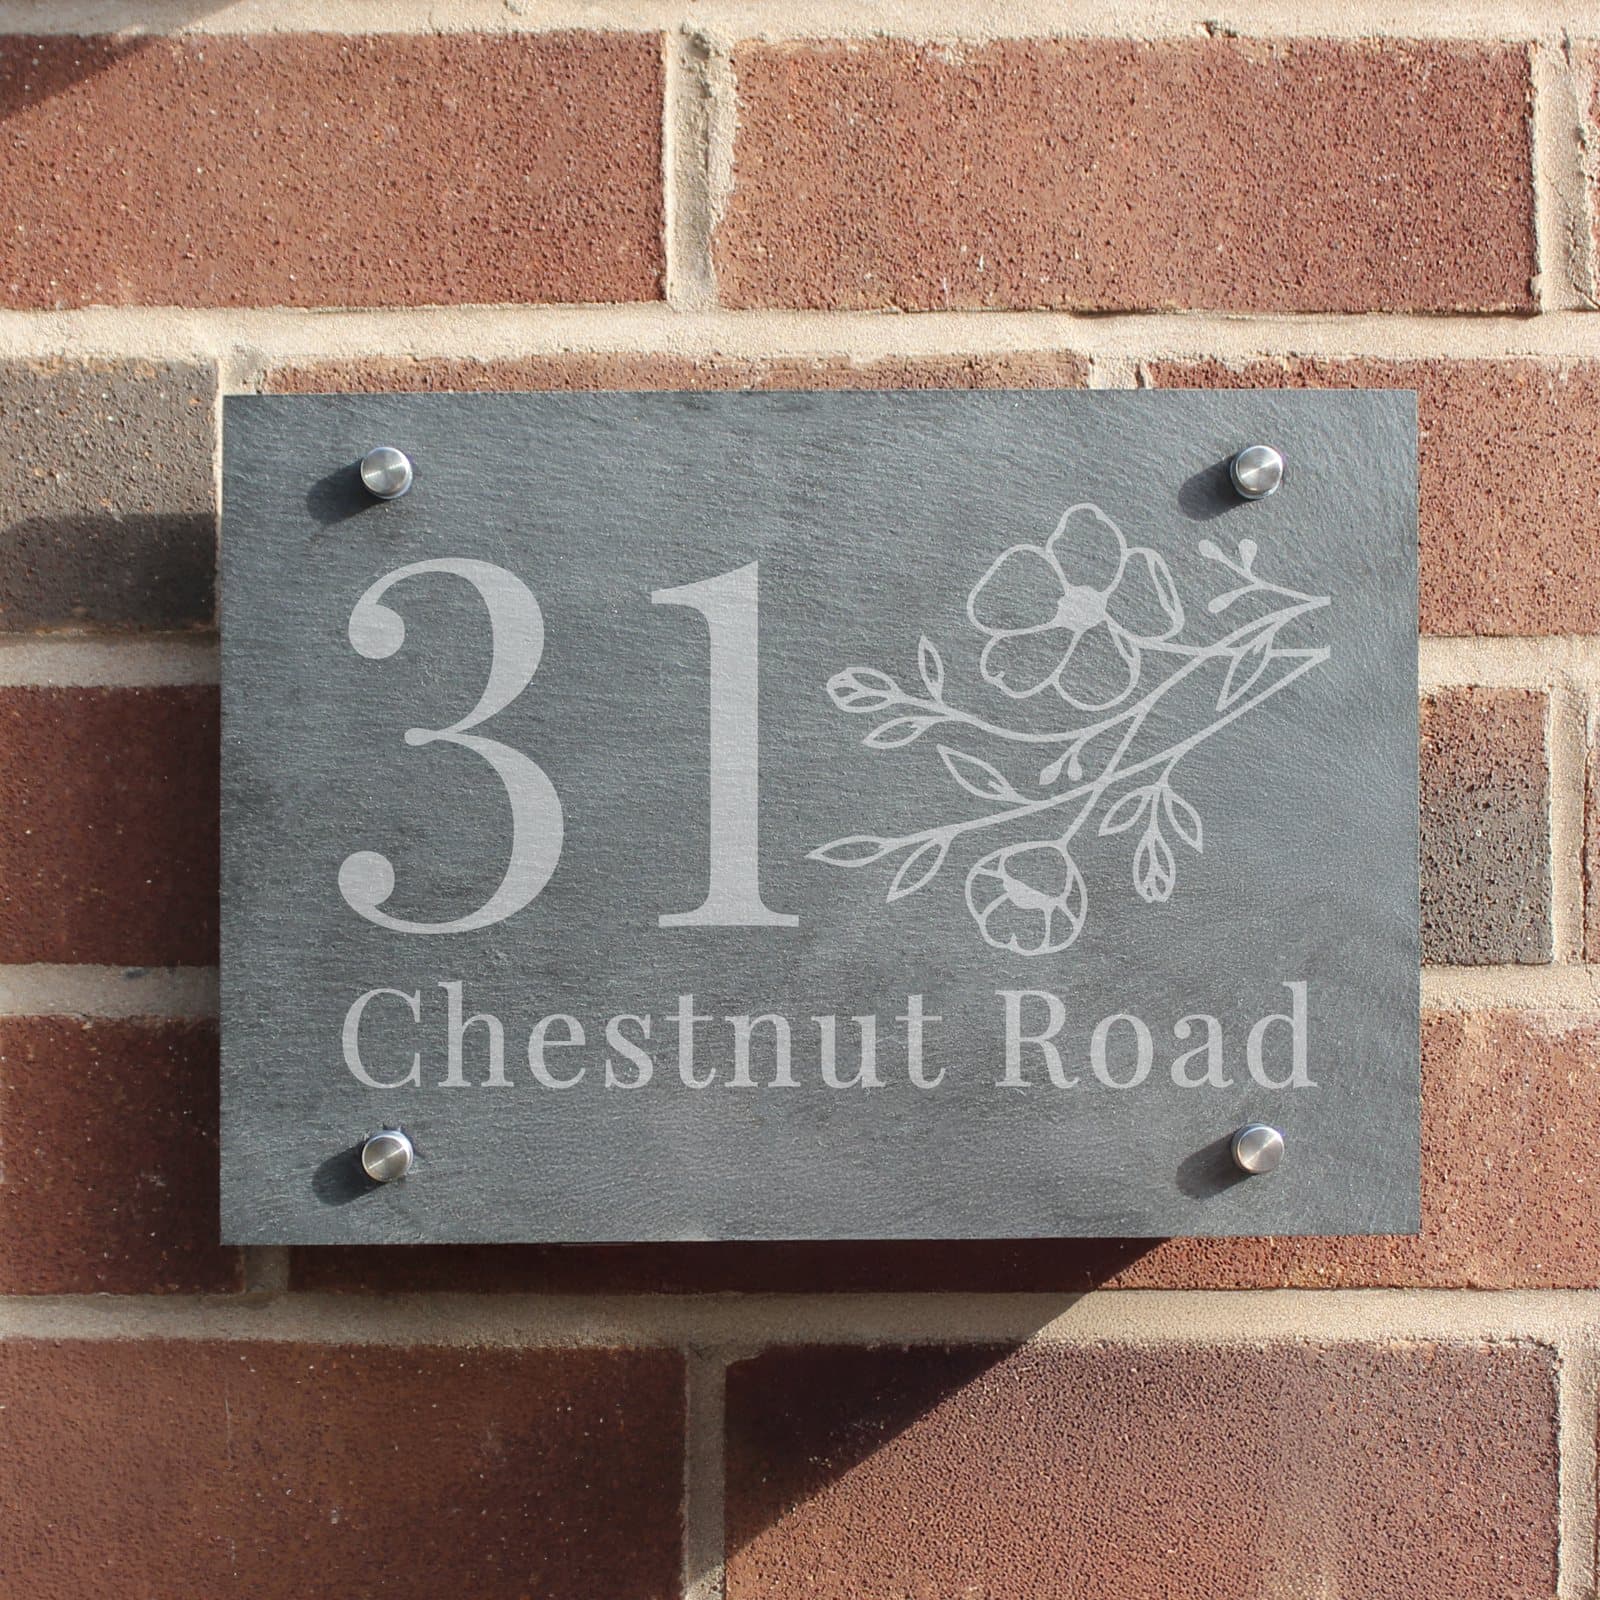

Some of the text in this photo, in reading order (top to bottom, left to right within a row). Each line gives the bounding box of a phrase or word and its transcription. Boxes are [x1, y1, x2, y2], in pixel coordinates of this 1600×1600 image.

[338, 557, 800, 935] 31
[341, 979, 1318, 1090] Chestnut Road
